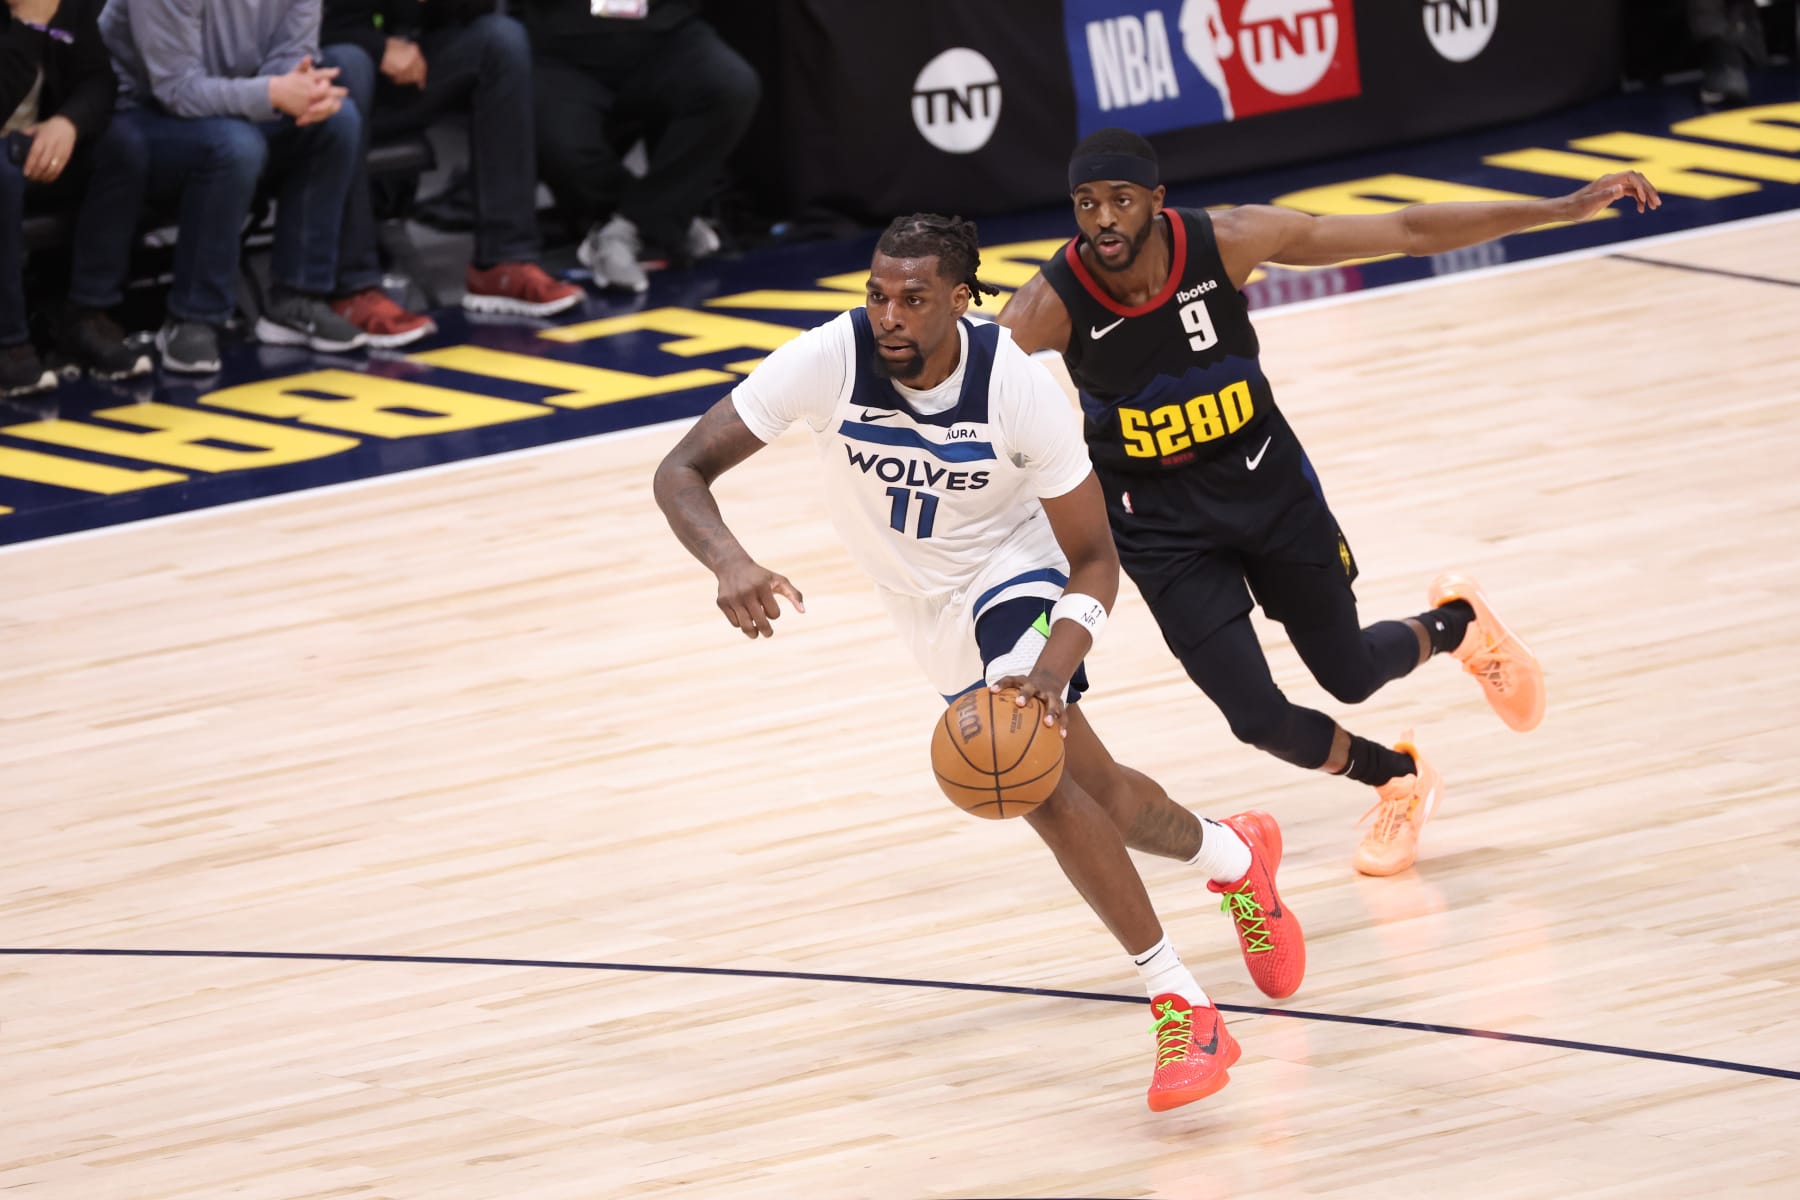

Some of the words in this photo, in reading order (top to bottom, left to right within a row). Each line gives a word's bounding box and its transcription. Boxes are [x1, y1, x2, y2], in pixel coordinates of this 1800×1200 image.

[1086, 9, 1180, 112] NBA
[1240, 7, 1336, 65] TNT
[913, 80, 1000, 125] TNT
[1175, 279, 1218, 304] ibotta
[1179, 299, 1219, 352] 9
[1117, 379, 1254, 459] 5280
[844, 442, 990, 491] WOLVES
[885, 485, 940, 540] 11
